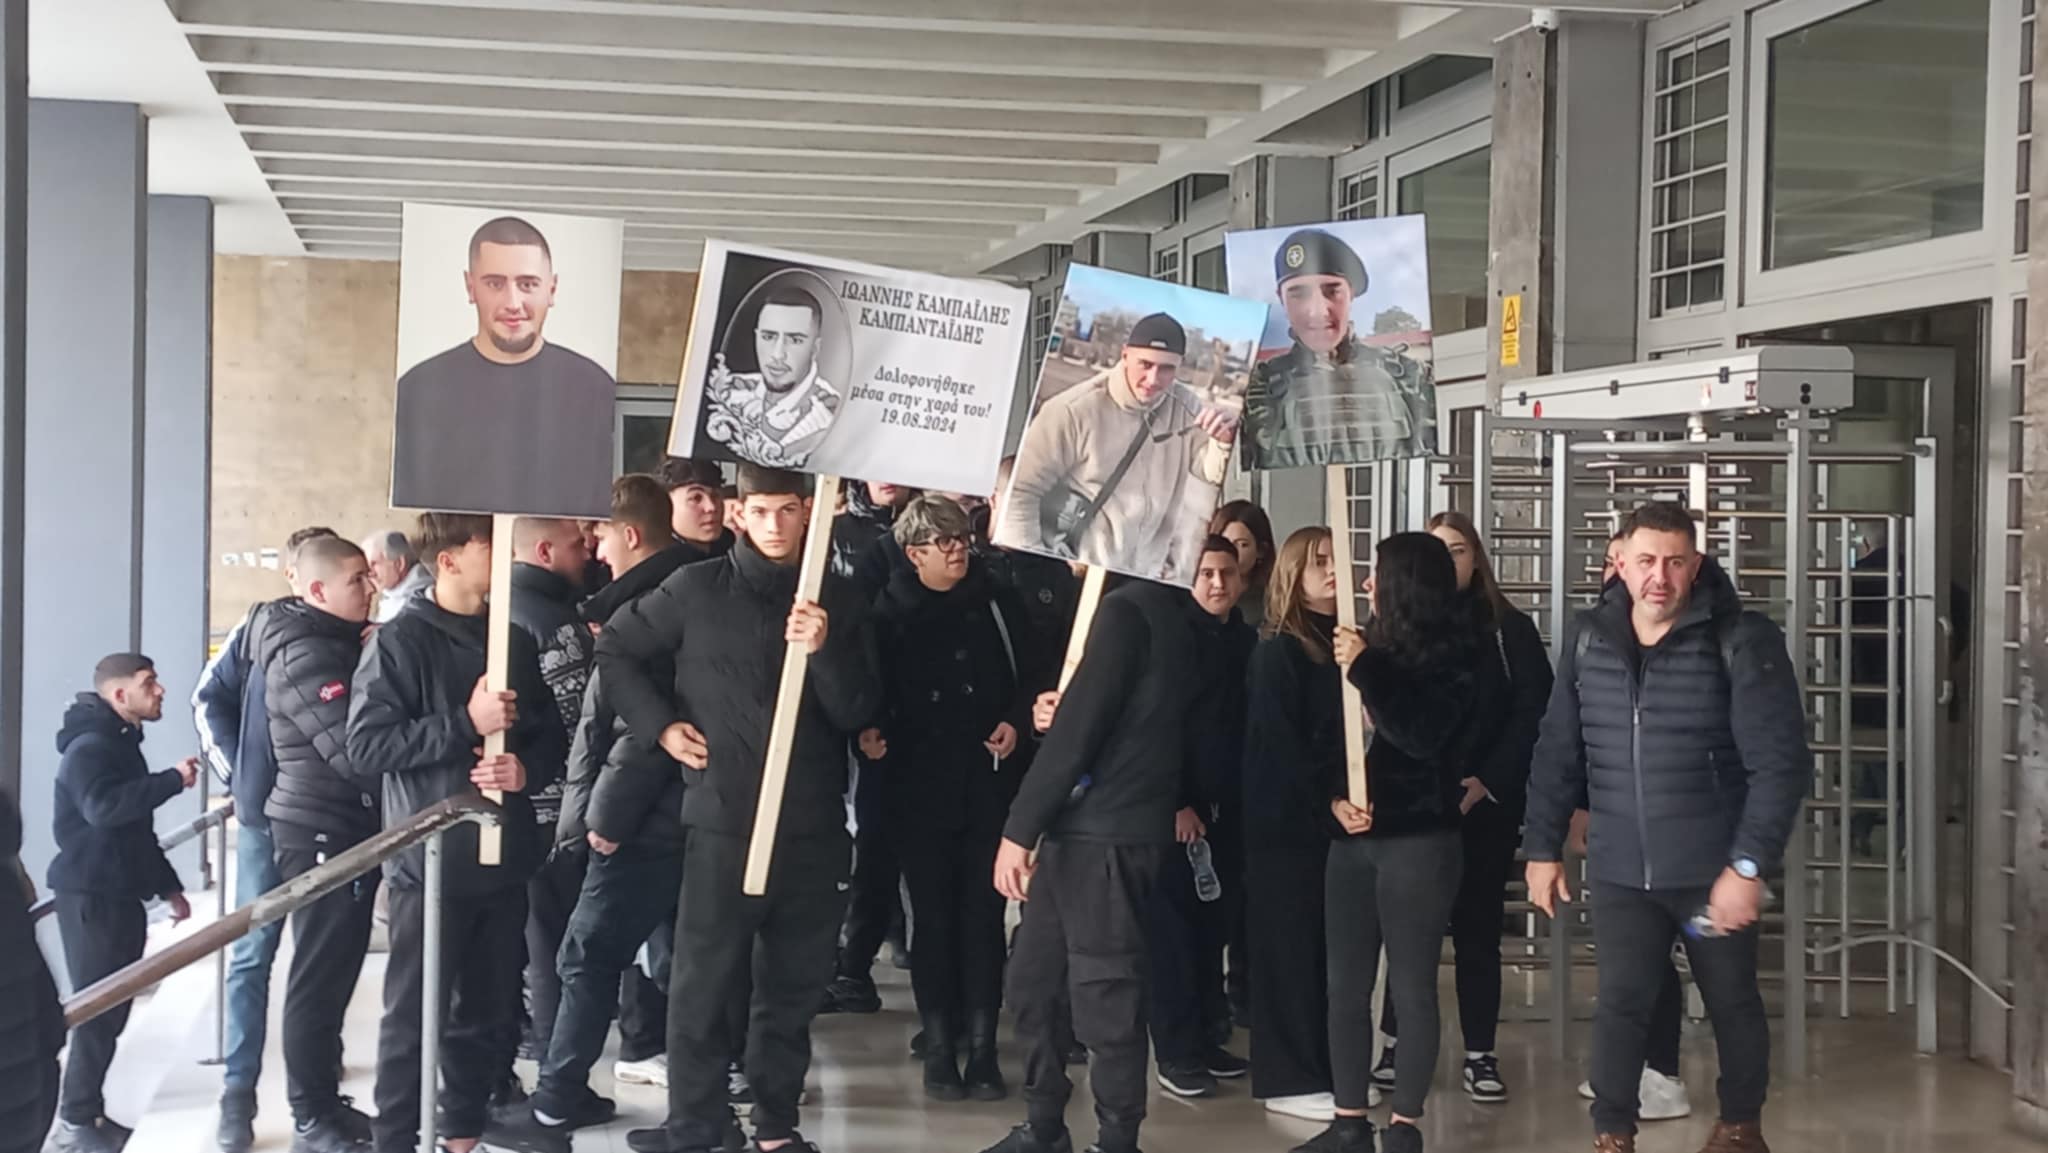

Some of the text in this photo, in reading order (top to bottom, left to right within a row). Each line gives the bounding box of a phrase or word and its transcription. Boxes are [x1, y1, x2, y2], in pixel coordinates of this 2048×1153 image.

[841, 280, 913, 309] ΙΩΑΝΝΗΣ
[859, 306, 984, 345] ΚΑΜΠΑΝΤΑΪΔΗΣ
[874, 365, 976, 396] Δολοφονήθηκε
[850, 383, 992, 418] μέσα στην χαρά του!
[880, 407, 957, 434] 19.08.2024
